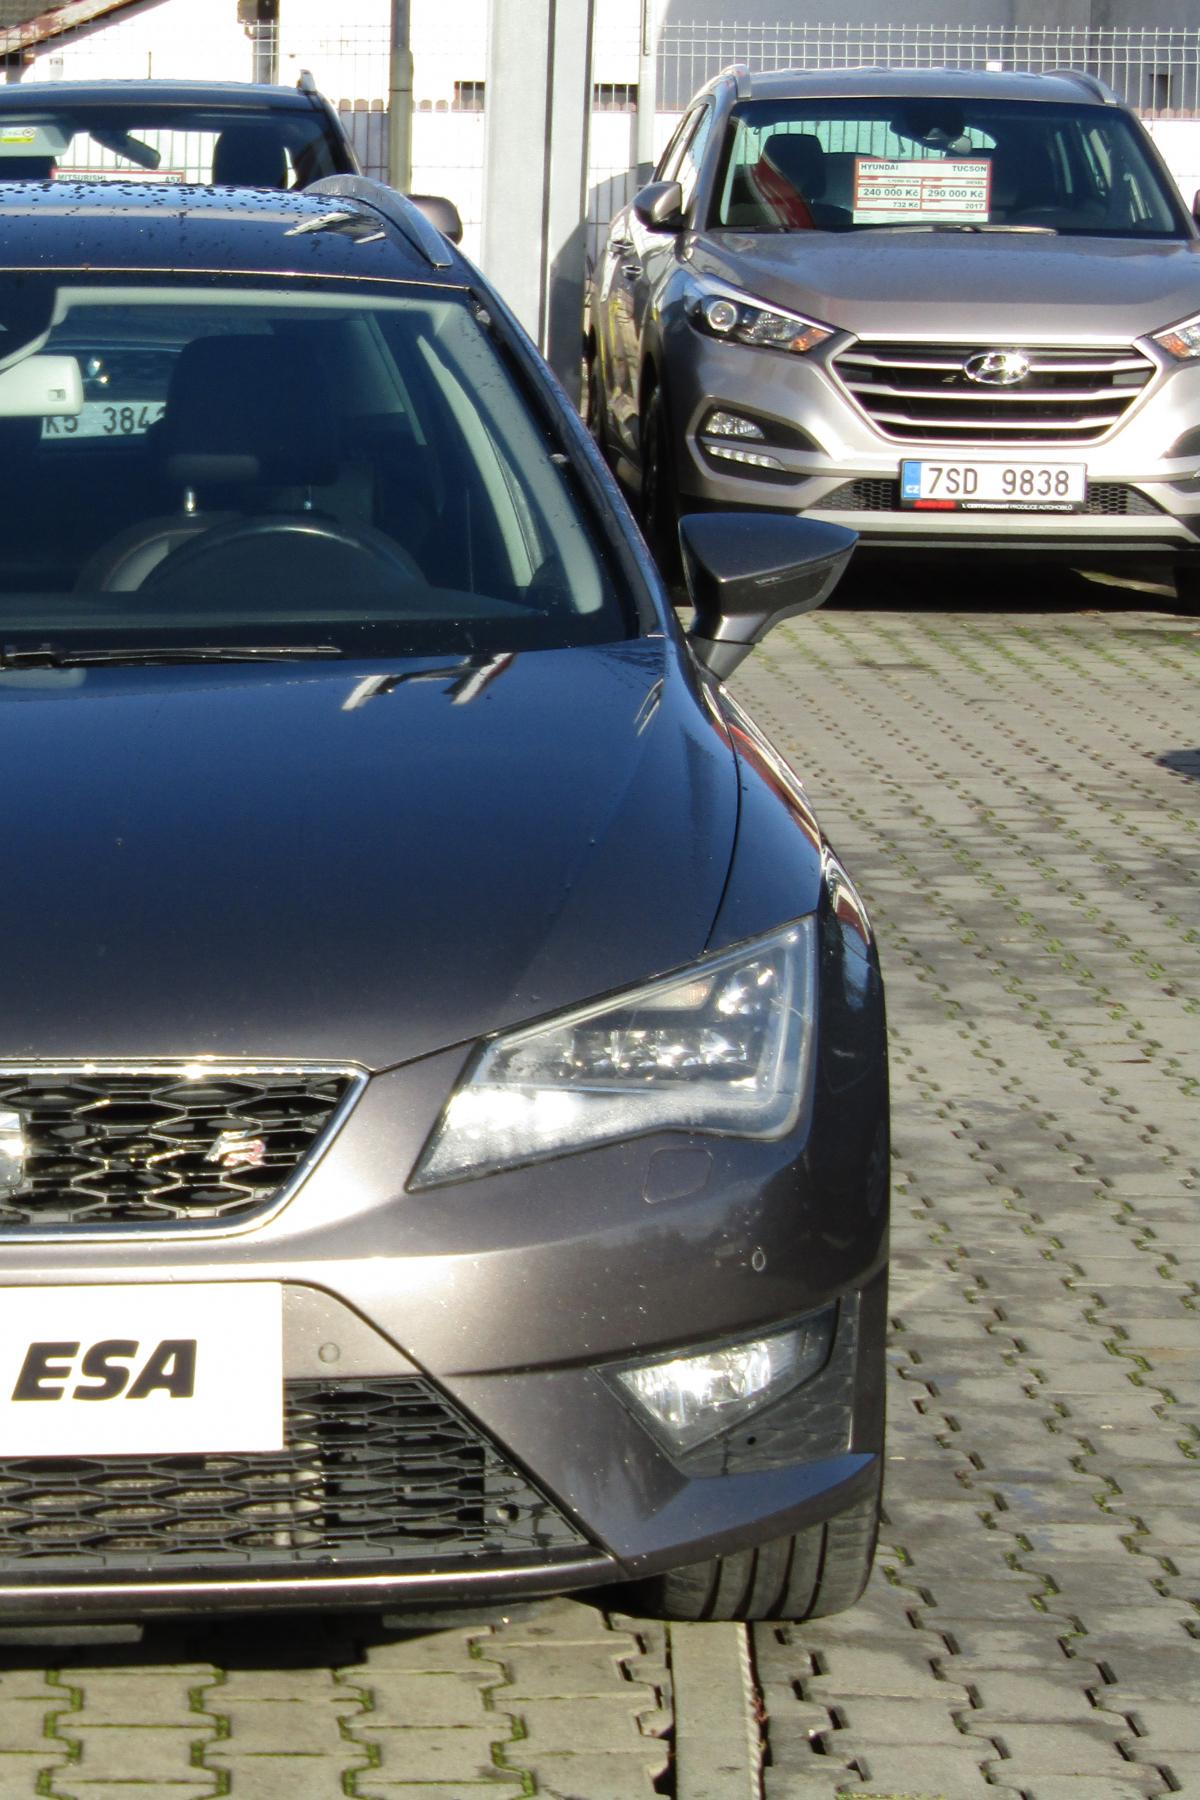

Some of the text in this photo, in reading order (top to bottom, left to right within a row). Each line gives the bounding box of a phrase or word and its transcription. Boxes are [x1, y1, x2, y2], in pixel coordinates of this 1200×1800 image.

[863, 188, 919, 197] 240 000 Kč
[928, 189, 984, 198] 290 000 Kč
[928, 467, 1069, 496] 7SD 9838
[905, 486, 920, 494] CZ
[11, 1339, 198, 1402] ESA
